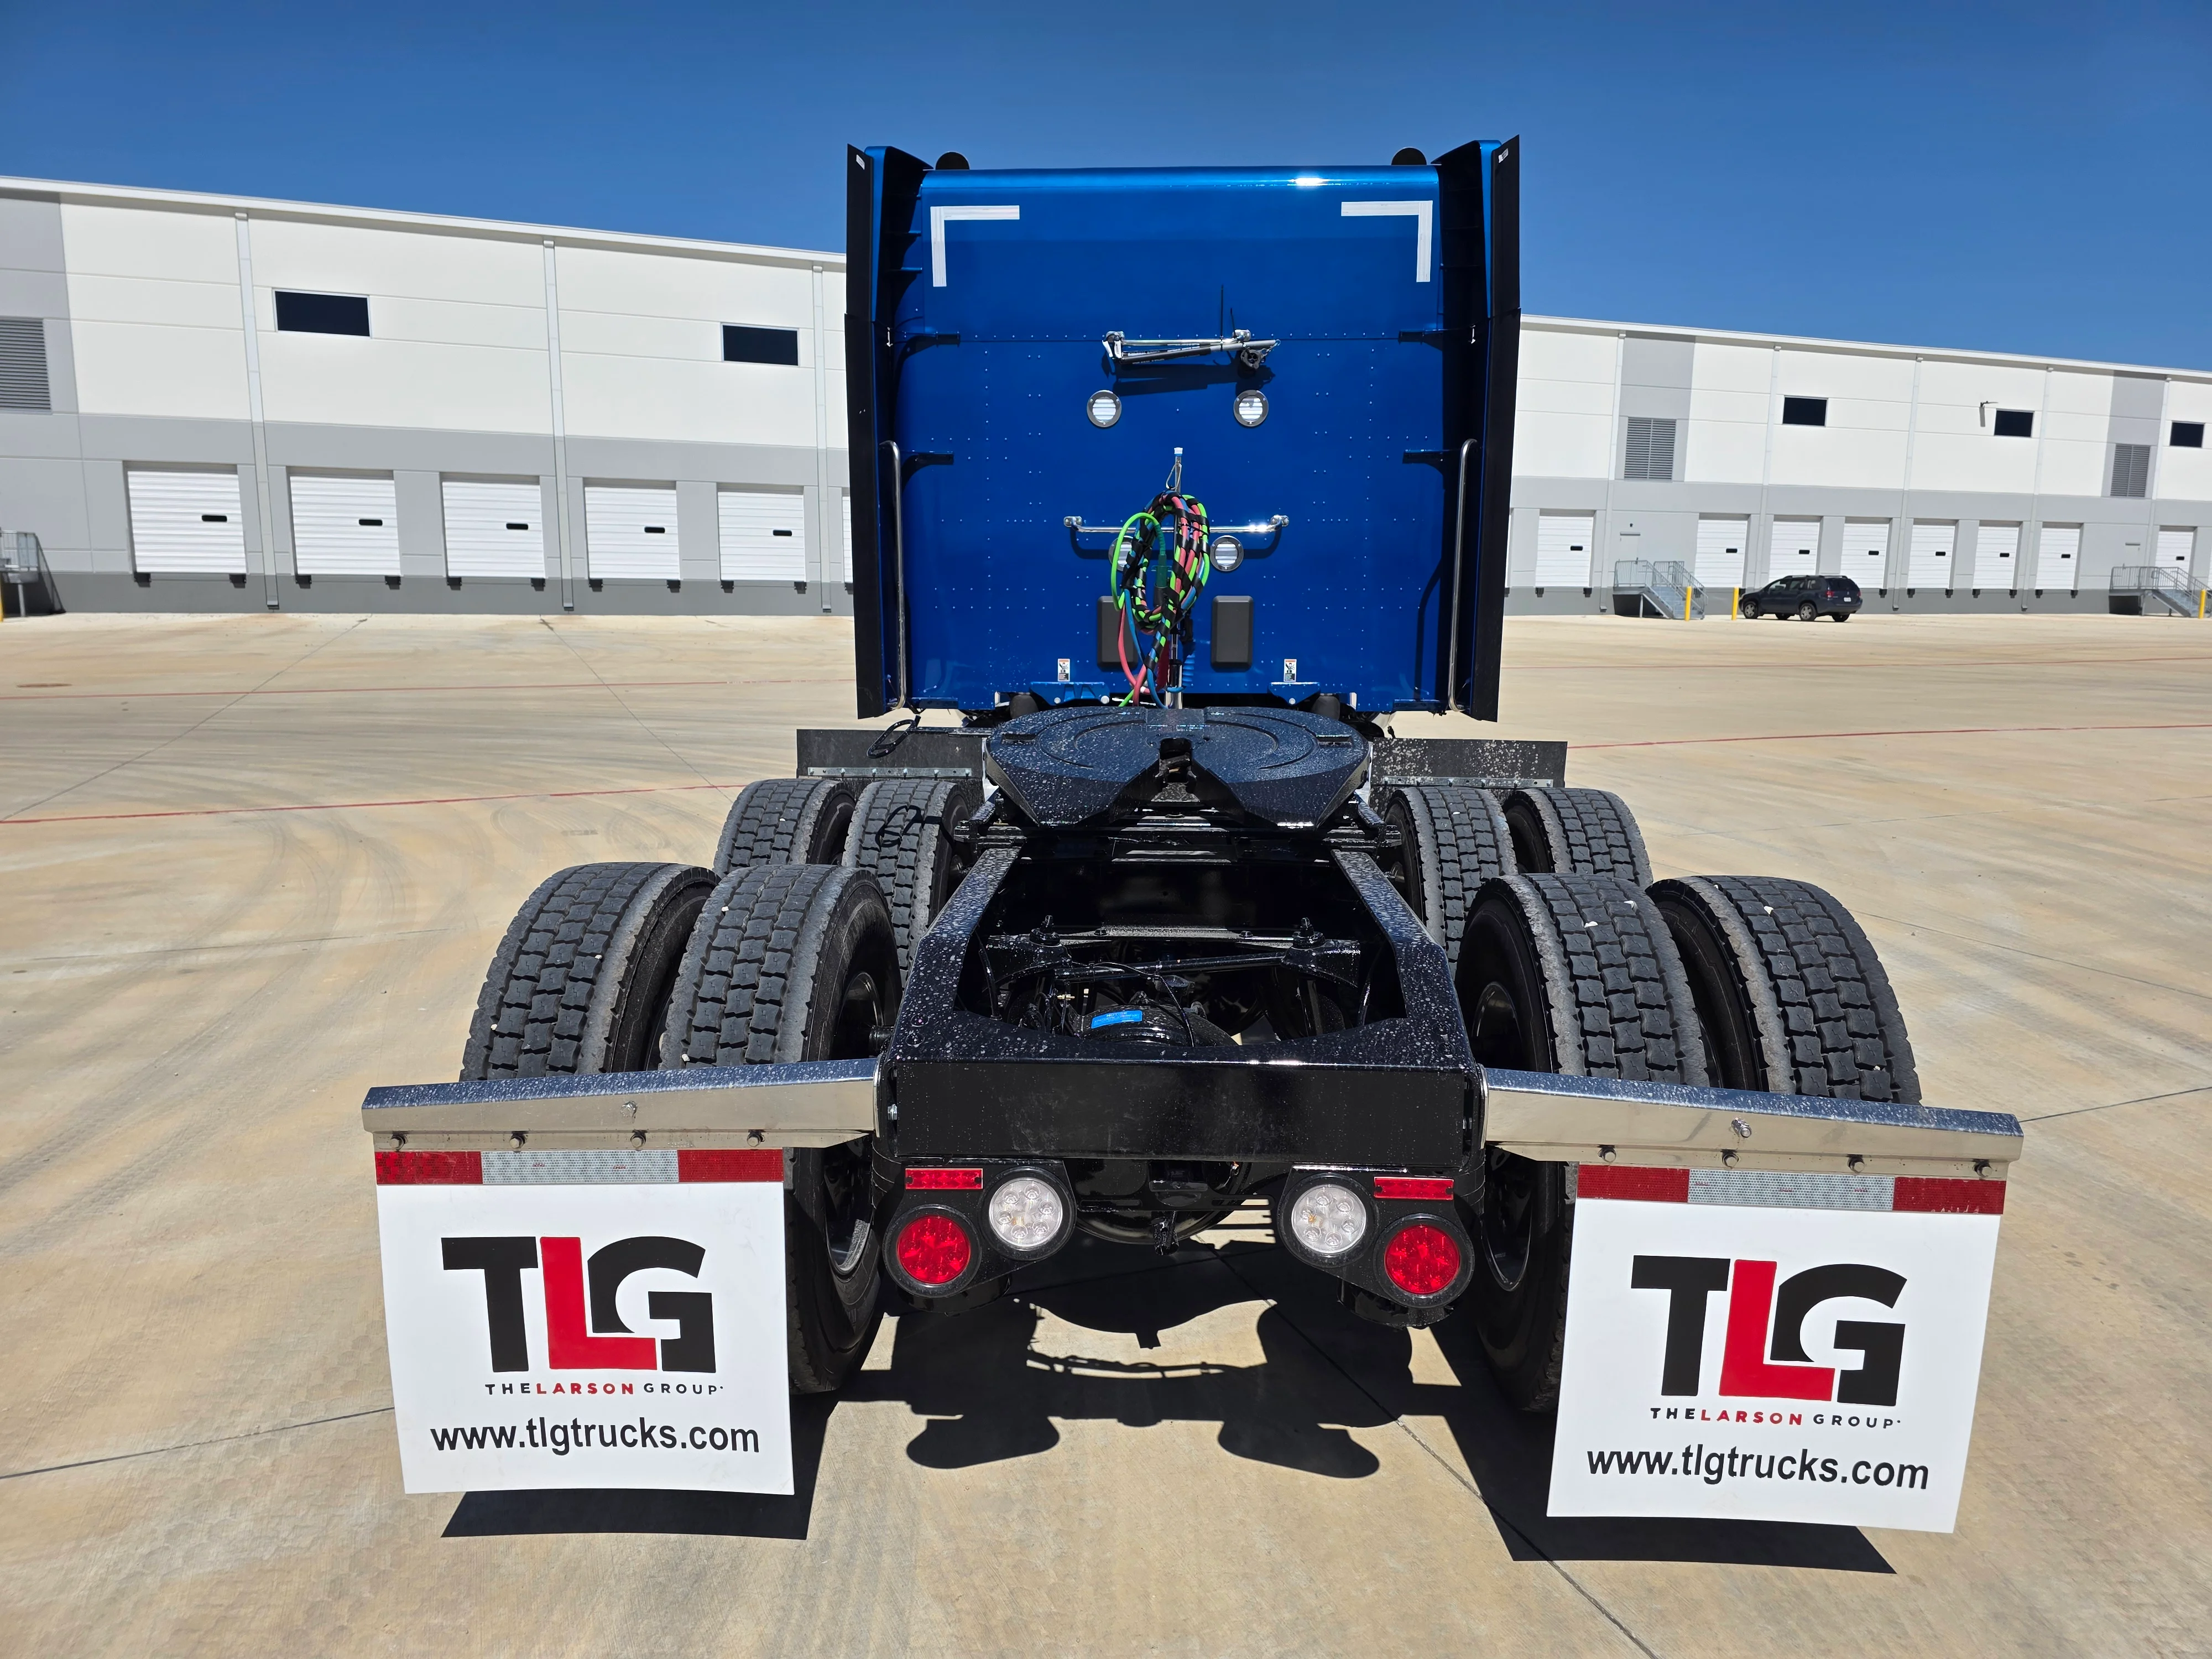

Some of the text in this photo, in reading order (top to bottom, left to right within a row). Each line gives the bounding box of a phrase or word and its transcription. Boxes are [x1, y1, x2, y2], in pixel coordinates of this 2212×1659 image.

[441, 1237, 716, 1373] TLG
[1631, 1255, 1907, 1406] TLG
[644, 1383, 717, 1395] GROUP
[430, 1417, 759, 1455] www.tlgtrucks.com
[1813, 1415, 1893, 1428] GROUP
[1587, 1444, 1928, 1489] www.tlgtrucks.com
